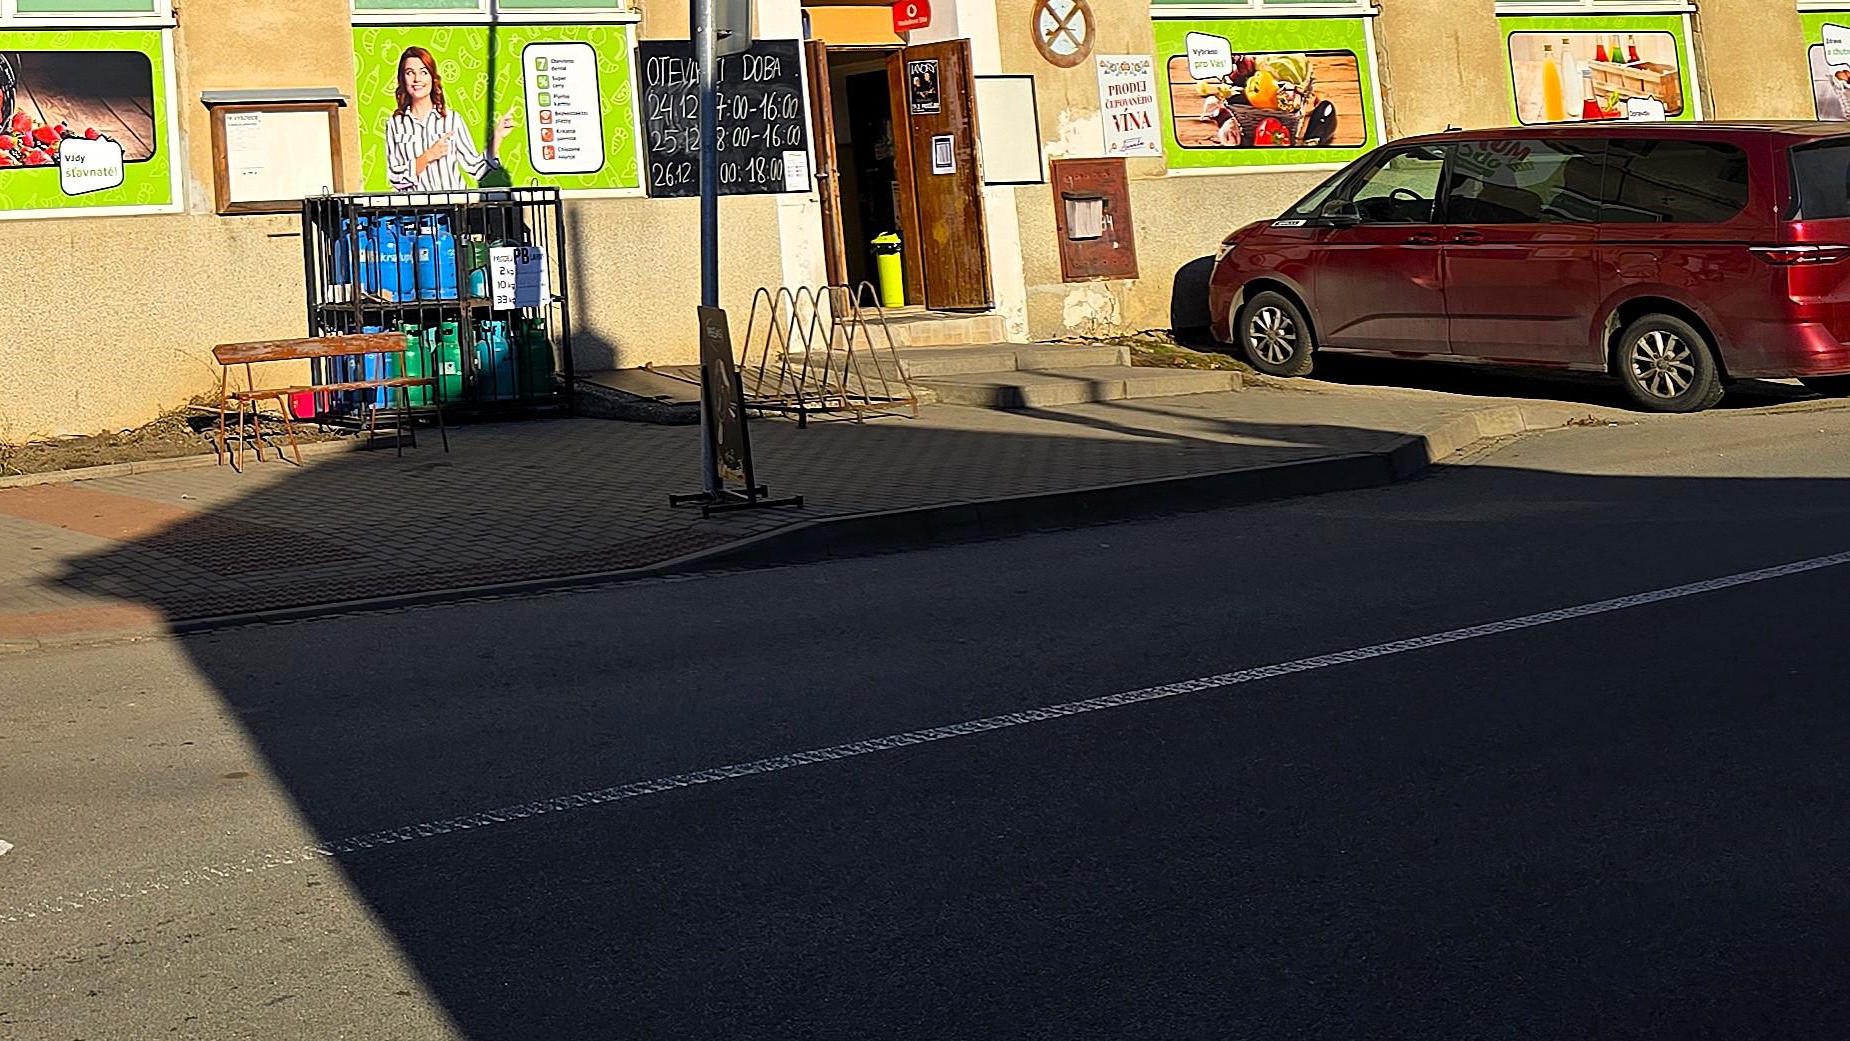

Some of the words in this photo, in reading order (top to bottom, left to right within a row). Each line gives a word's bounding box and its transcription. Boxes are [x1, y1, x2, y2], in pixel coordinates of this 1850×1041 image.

[742, 54, 782, 82] DOBA
[1108, 80, 1146, 96] PRODEJ
[1112, 108, 1152, 132] VÍNA
[513, 247, 530, 265] PB
